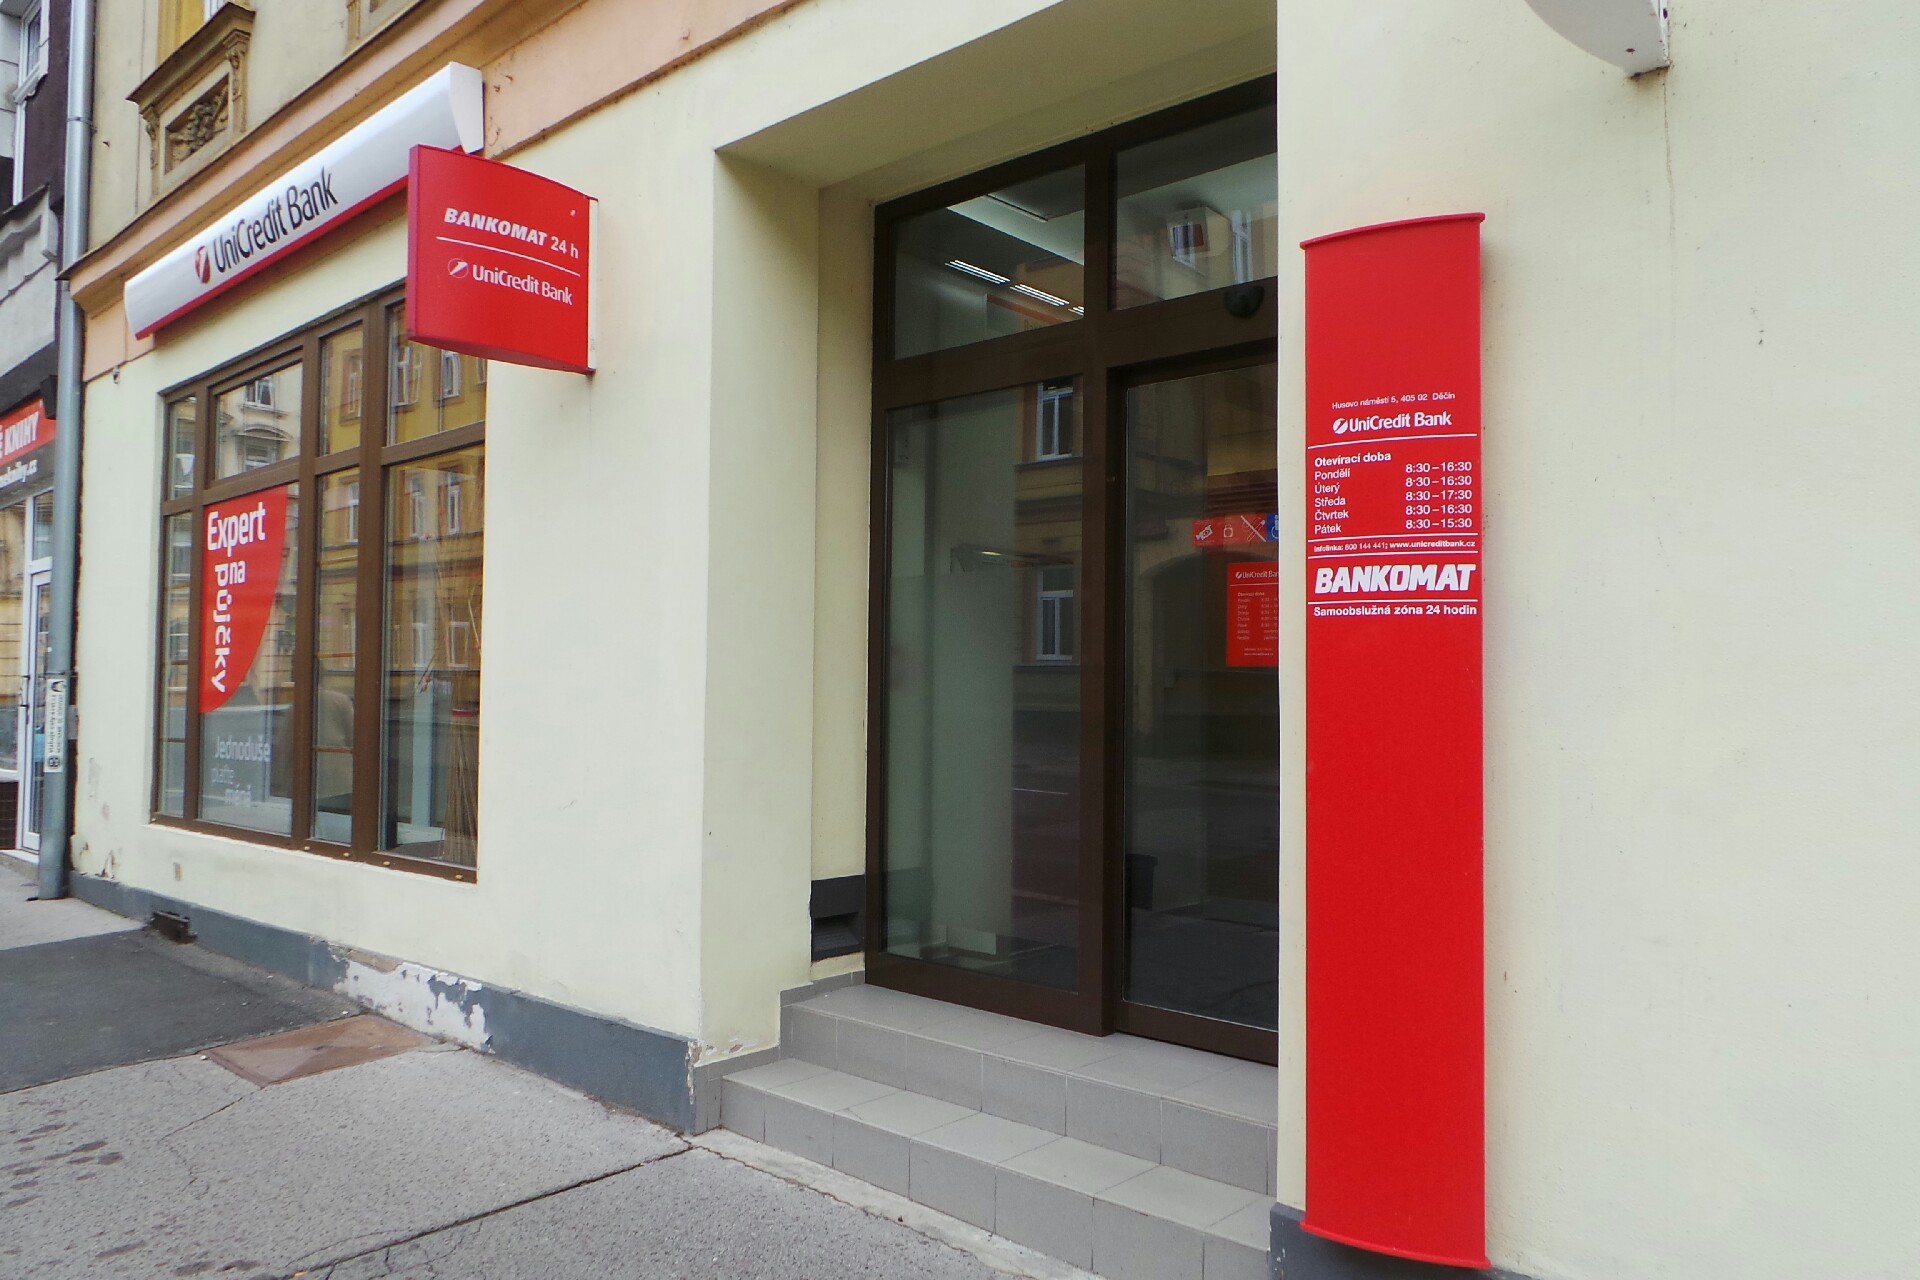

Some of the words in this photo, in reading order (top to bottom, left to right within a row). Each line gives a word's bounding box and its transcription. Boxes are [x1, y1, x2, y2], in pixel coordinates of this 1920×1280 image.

[213, 195, 288, 273] UniCredit
[286, 166, 339, 230] Bank
[444, 207, 548, 246] BANKOMAT
[550, 236, 568, 254] 24
[570, 243, 579, 259] h
[472, 264, 540, 295] UniCredit
[541, 281, 573, 306] Bank
[1332, 401, 1359, 410] Husovo
[1360, 396, 1390, 406] náměstí
[1400, 394, 1416, 402] 405
[1417, 393, 1428, 401] 02
[1432, 391, 1456, 400] Děčín
[1349, 413, 1411, 433] UniCredit
[1414, 410, 1453, 427] Bank
[4, 411, 40, 456] KNIHY
[1314, 453, 1361, 467] Otevírací
[1362, 451, 1392, 462] doba
[1314, 468, 1351, 481] Pondělí
[1314, 482, 1341, 495] Úterý
[1314, 496, 1346, 508] Středa
[1314, 509, 1349, 522] Čtvrtek
[207, 501, 267, 558] Expert
[1314, 523, 1342, 535] Pátek
[1389, 540, 1476, 549] www.unicreditbank.cz
[229, 560, 246, 585] na
[1314, 563, 1477, 594] BANKOMAT
[1313, 605, 1391, 617] Samoobslužná
[1393, 605, 1424, 615] zóna
[1425, 604, 1441, 615] 24
[1443, 604, 1477, 615] hodin
[210, 563, 233, 693] půjčky
